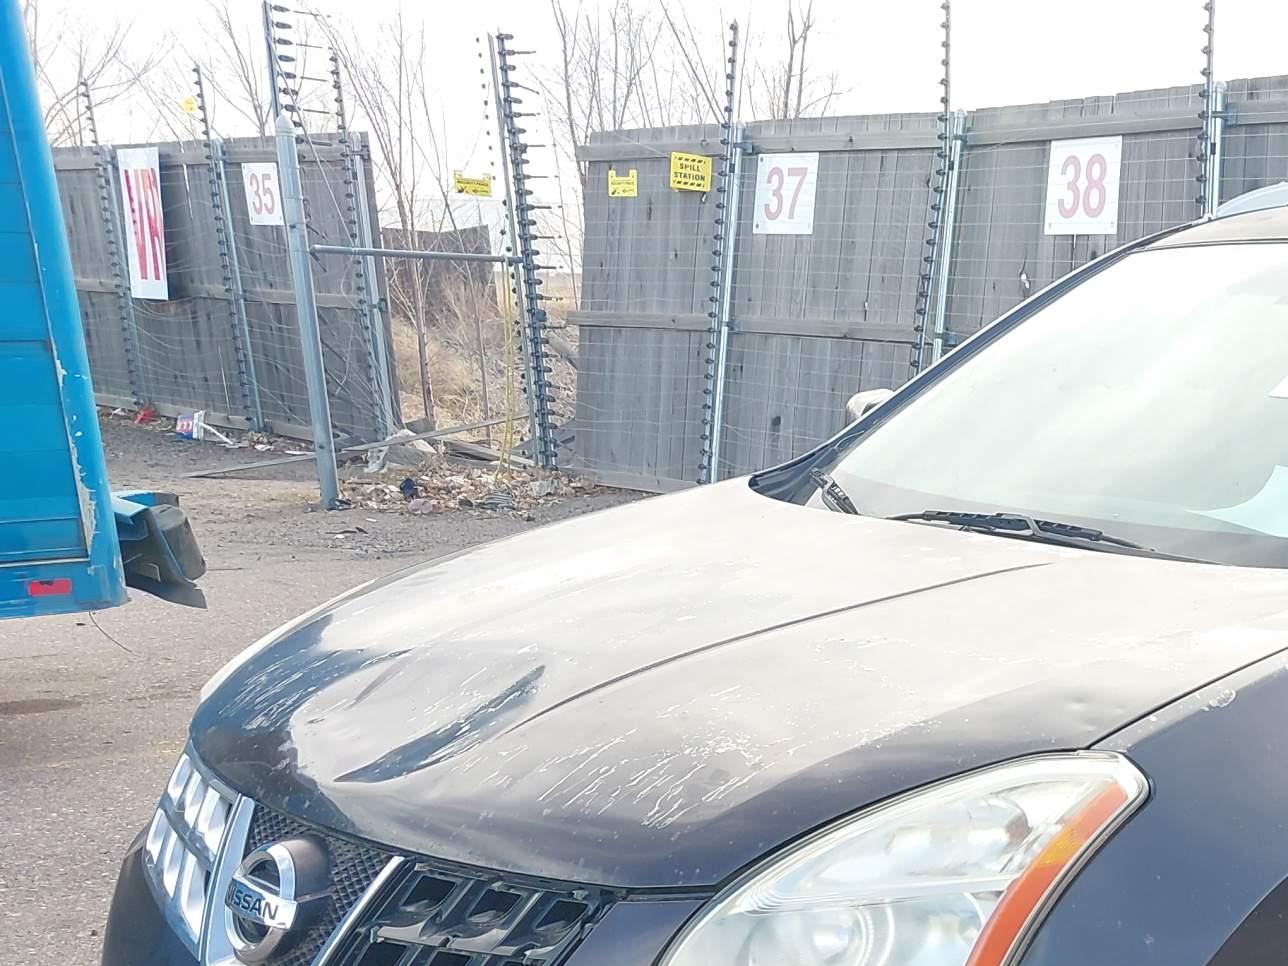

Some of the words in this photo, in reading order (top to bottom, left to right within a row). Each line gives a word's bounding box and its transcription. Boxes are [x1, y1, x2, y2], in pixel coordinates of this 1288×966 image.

[673, 171, 706, 182] STATION
[679, 162, 701, 173] SPILL
[1057, 152, 1108, 220] 38
[249, 172, 276, 216] 35
[763, 165, 809, 222] 37
